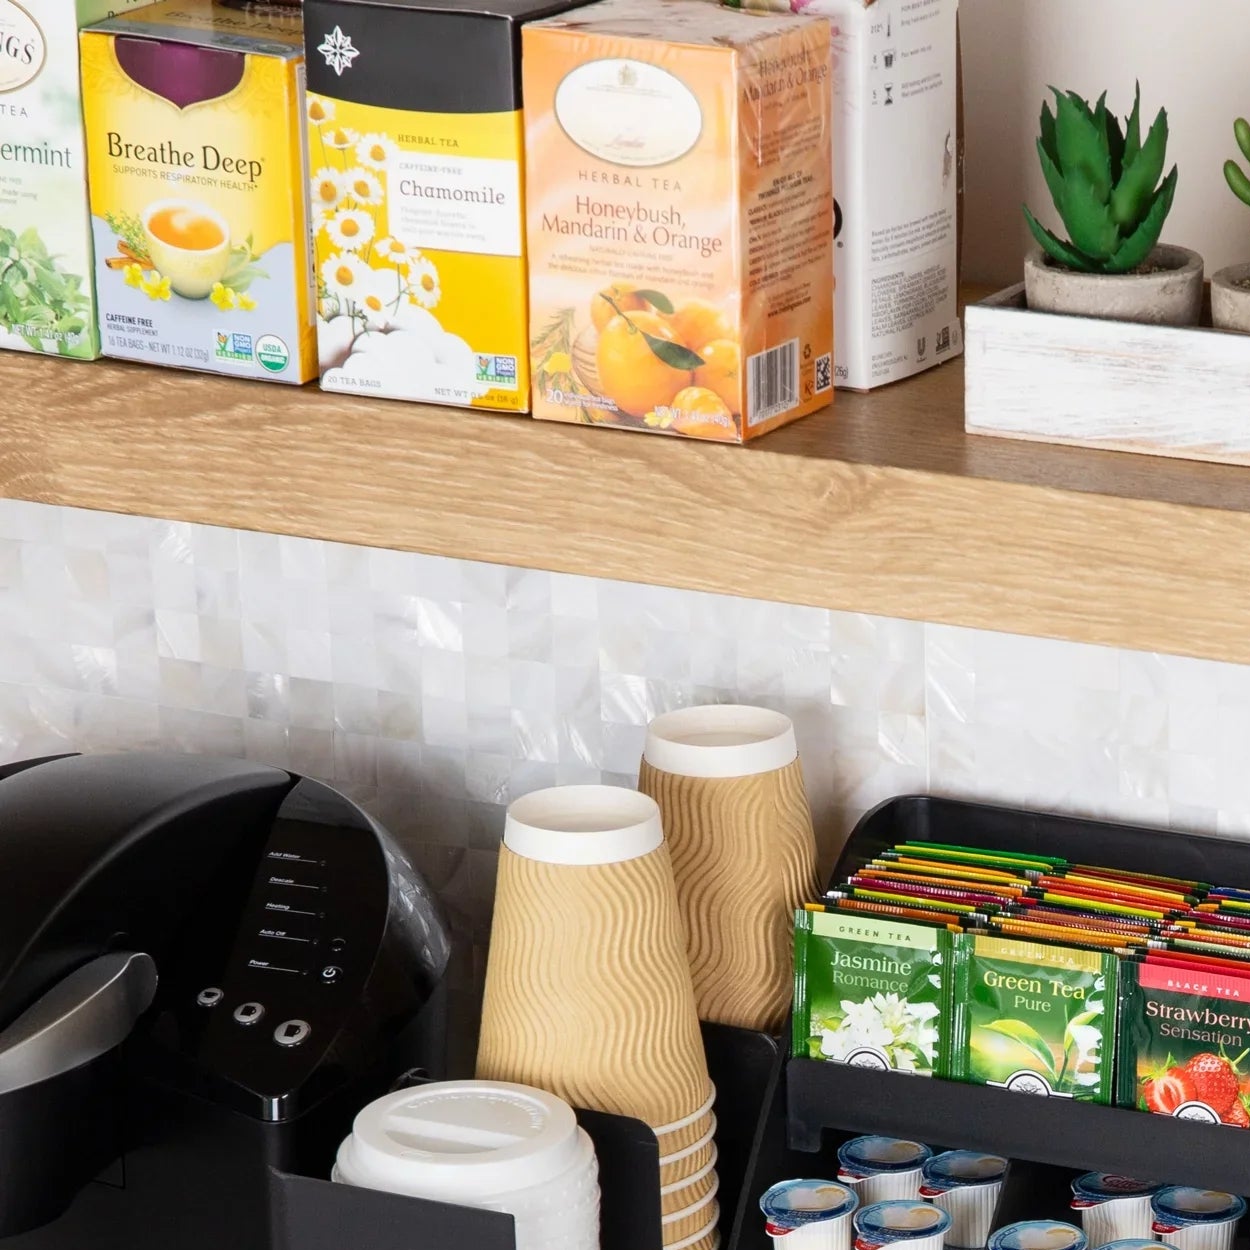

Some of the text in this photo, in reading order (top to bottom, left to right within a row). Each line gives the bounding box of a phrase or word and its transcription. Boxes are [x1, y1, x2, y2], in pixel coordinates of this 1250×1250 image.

[0, 31, 35, 65] GS
[107, 132, 195, 168] Breathe
[397, 134, 460, 149] HERBAL TEA
[112, 165, 158, 180] SUPPORTS
[159, 171, 219, 188] RESPIRATORY
[578, 170, 682, 192] HERBAL TEA
[399, 179, 506, 206] Chamomile
[575, 195, 687, 229] Honeybush,
[541, 213, 723, 259] Mandarin & Orange
[105, 313, 154, 329] CAFFEINE FREE
[116, 336, 127, 348] TEA
[127, 338, 144, 351] BAGS
[148, 341, 161, 353] NET
[161, 343, 171, 355] WT
[262, 343, 283, 354] USDA
[495, 357, 515, 366] NON
[495, 363, 516, 373] GMO
[340, 377, 357, 387] TEA
[358, 379, 382, 389] BAGS
[434, 387, 468, 399] NET WT
[546, 388, 563, 404] 20
[839, 926, 912, 942] GREEN TEA
[831, 951, 912, 977] Jasmine
[1001, 947, 1075, 966] GREEN TEA
[833, 970, 909, 994] Romance
[983, 970, 1085, 1000] Green Tea
[1167, 980, 1240, 998] BLACK TEA
[1014, 995, 1052, 1013] Pure
[1160, 1023, 1242, 1047] Sensation
